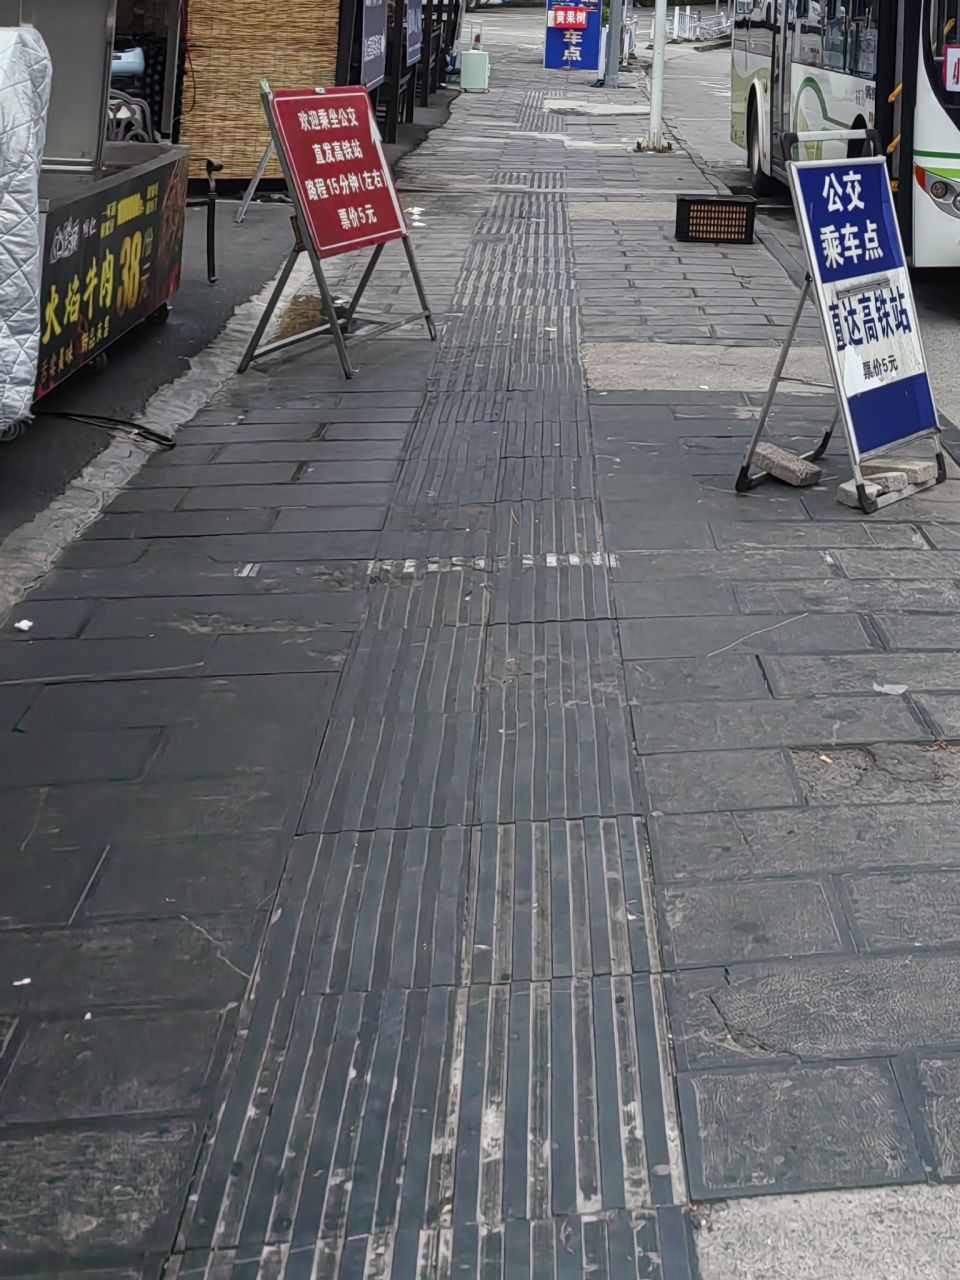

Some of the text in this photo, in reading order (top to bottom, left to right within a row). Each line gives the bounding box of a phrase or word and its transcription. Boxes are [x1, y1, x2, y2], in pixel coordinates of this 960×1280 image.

[556, 11, 587, 24] 黄果树
[297, 106, 359, 132] 欢迎乘坐公交
[312, 138, 364, 165] 直发高铁站
[822, 170, 865, 213] 公交
[337, 204, 378, 230] 票价5元
[820, 219, 884, 269] 乘车点
[116, 230, 143, 316] 38
[42, 248, 114, 345] 火焰牛肉
[828, 284, 913, 353] 直达高铁站
[862, 354, 899, 380] 票价5元
